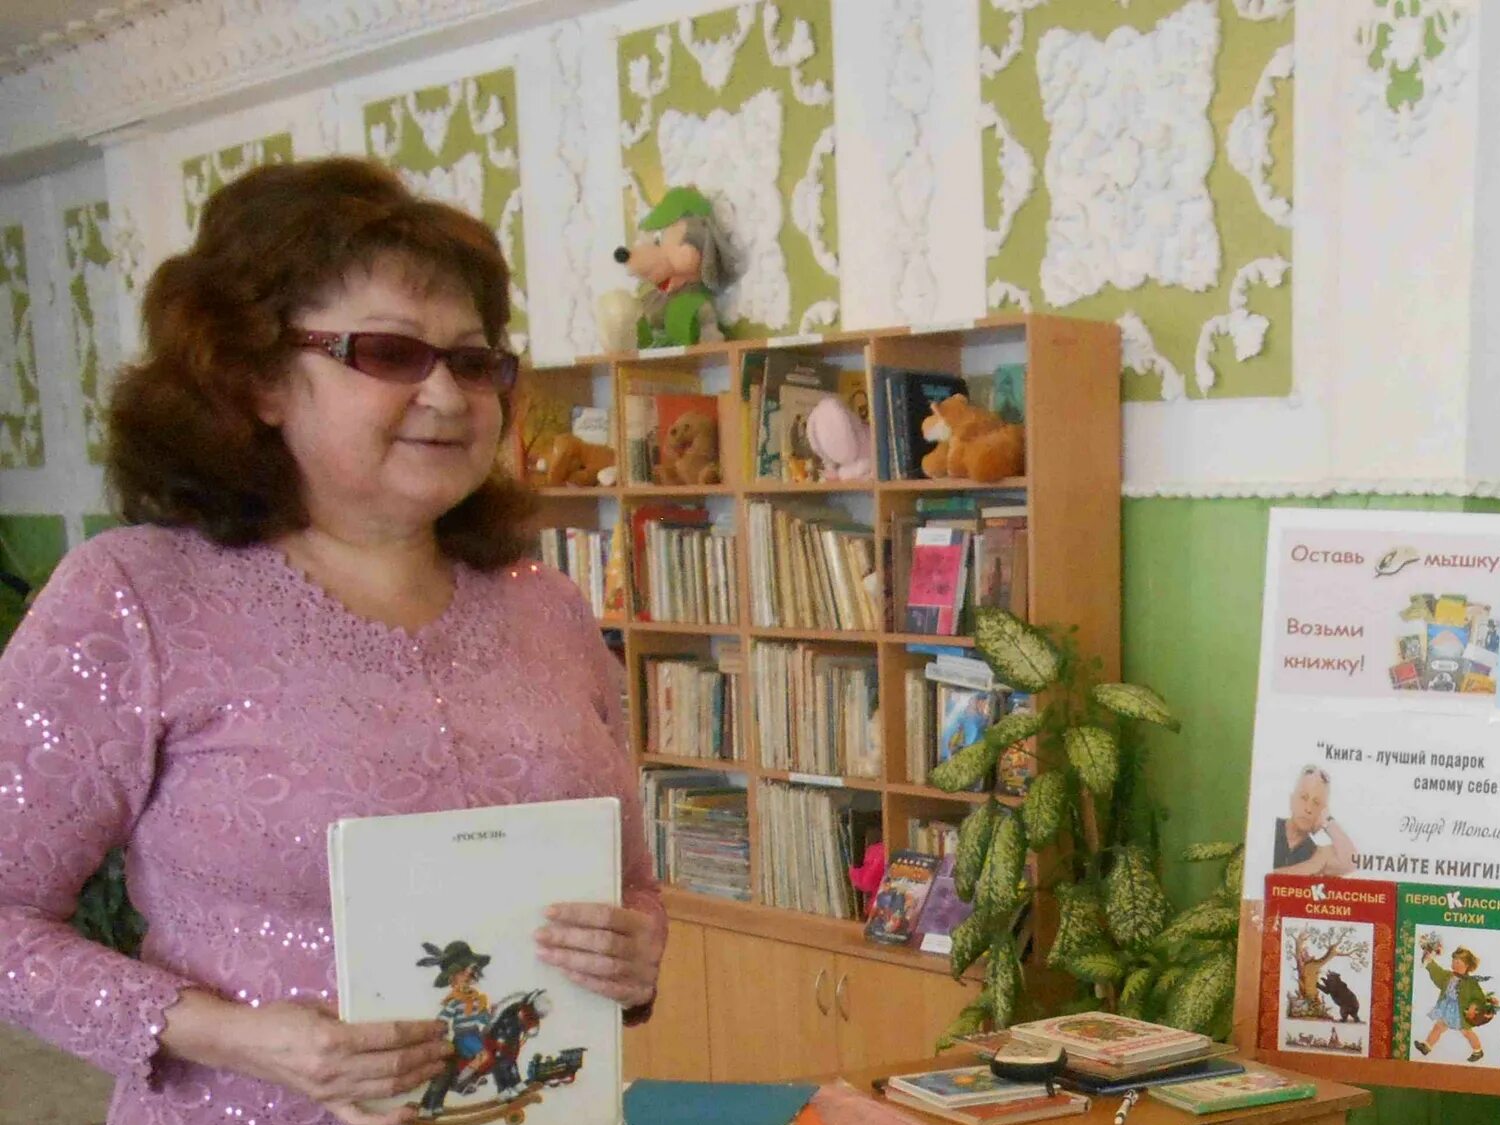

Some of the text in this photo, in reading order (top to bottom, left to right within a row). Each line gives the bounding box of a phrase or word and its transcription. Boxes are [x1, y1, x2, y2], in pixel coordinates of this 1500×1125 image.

[1291, 545, 1365, 565] Оставь
[1287, 618, 1365, 638] Возьми
[1284, 654, 1365, 676] книжку!
[1376, 749, 1426, 766] лучший
[1430, 753, 1485, 771] подарок
[1413, 776, 1464, 795] самому
[1400, 816, 1446, 842] Эдуард
[1350, 854, 1500, 880] ЧИТАЙТЕ КНИГИ!
[1305, 903, 1352, 916] СКАЗКИ
[1443, 911, 1485, 925] СТИХИ
